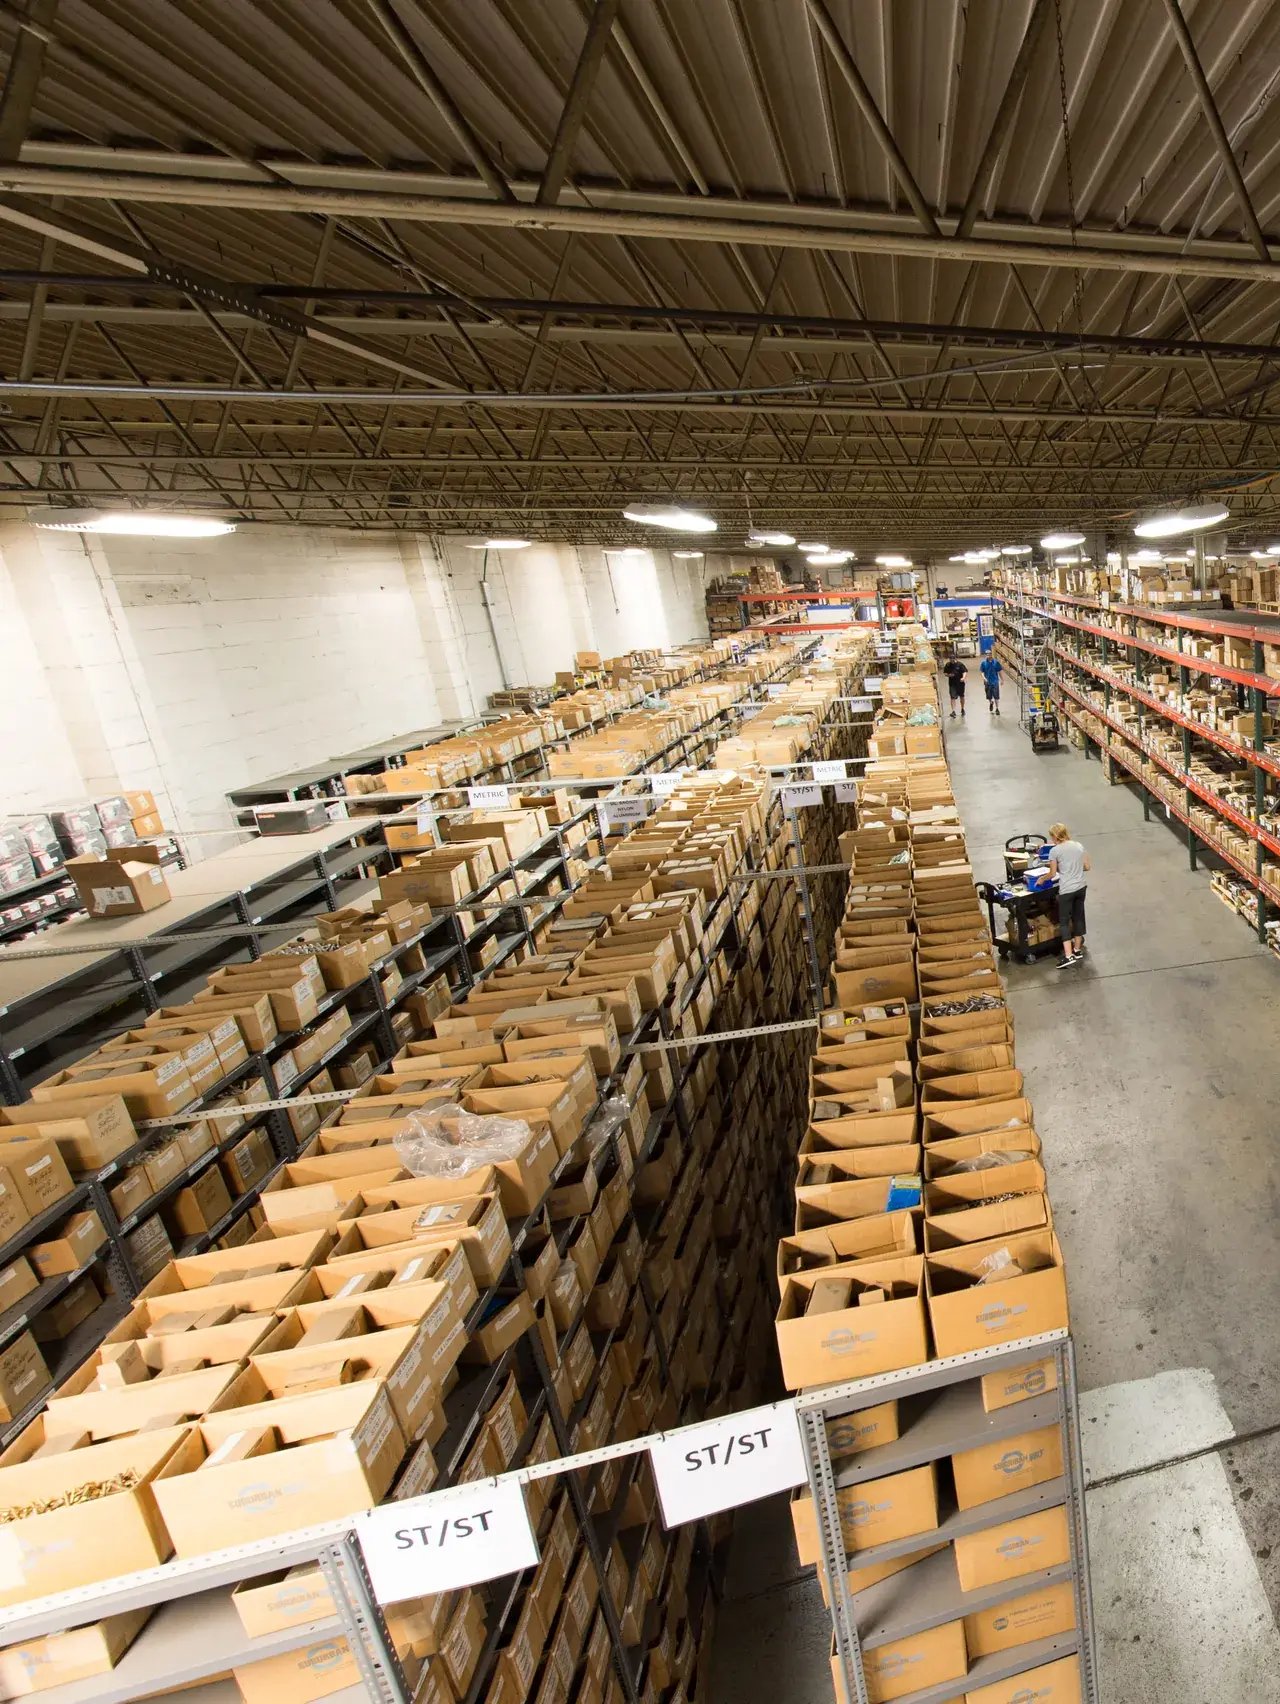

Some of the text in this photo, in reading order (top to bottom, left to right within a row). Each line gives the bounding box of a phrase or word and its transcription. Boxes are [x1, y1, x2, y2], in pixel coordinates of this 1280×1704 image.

[816, 765, 843, 774] METRIC
[473, 790, 505, 800] METRIC
[791, 786, 815, 795] ST/ST
[685, 1428, 772, 1472] ST/ST
[394, 1510, 493, 1550] ST/ST
